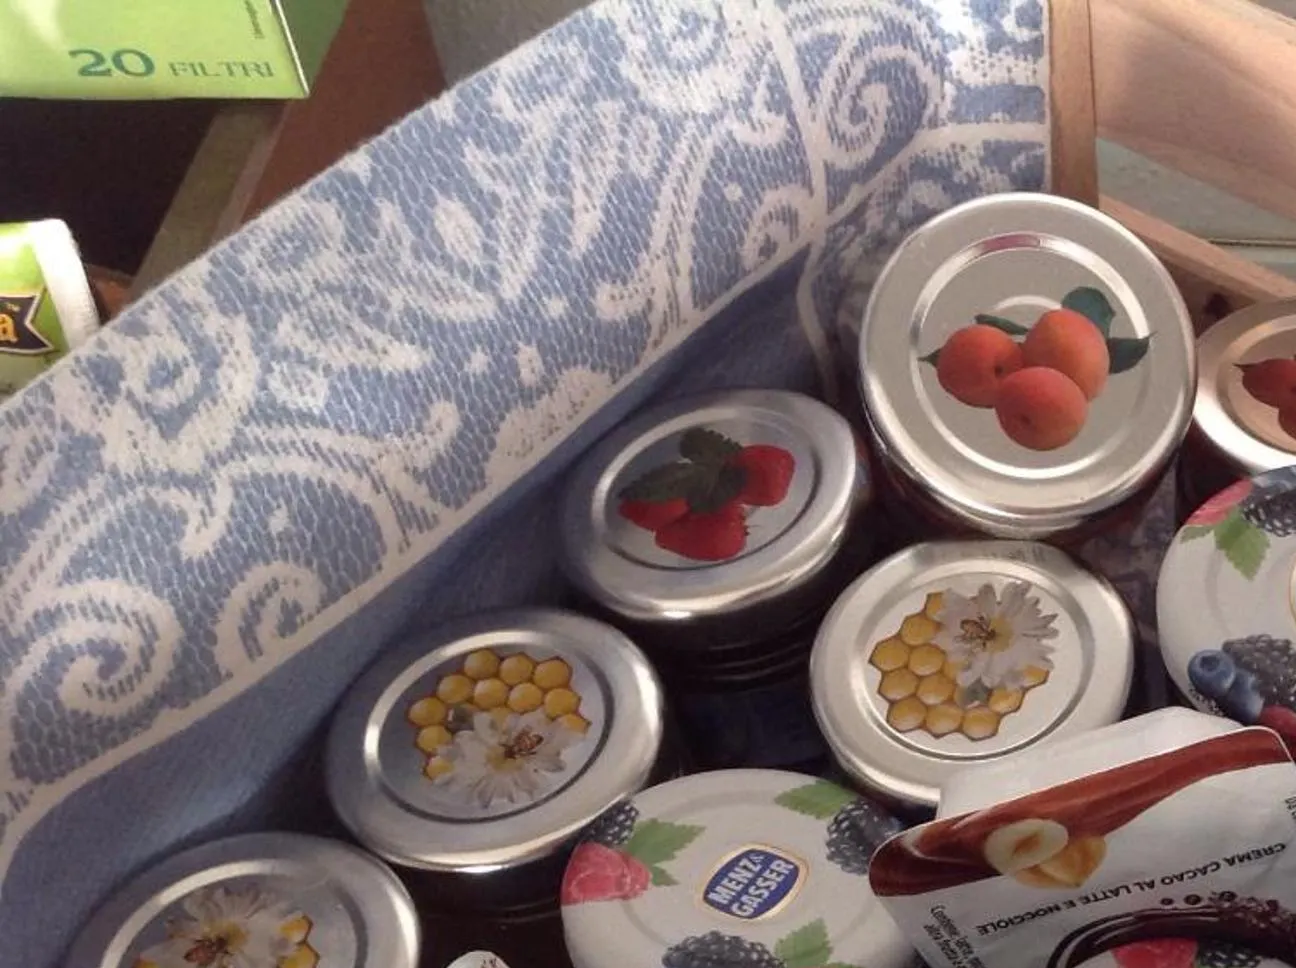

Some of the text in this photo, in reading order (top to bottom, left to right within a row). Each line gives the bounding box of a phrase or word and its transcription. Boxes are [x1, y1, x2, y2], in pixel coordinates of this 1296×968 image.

[69, 49, 275, 78] 20 FILTRI
[1224, 842, 1286, 867] CREMA
[1133, 877, 1155, 893] AL
[1161, 861, 1220, 886] CACAO
[731, 859, 795, 916] GASSER
[1077, 884, 1132, 908] LATTE
[976, 903, 1062, 936] NOCCIOLE
